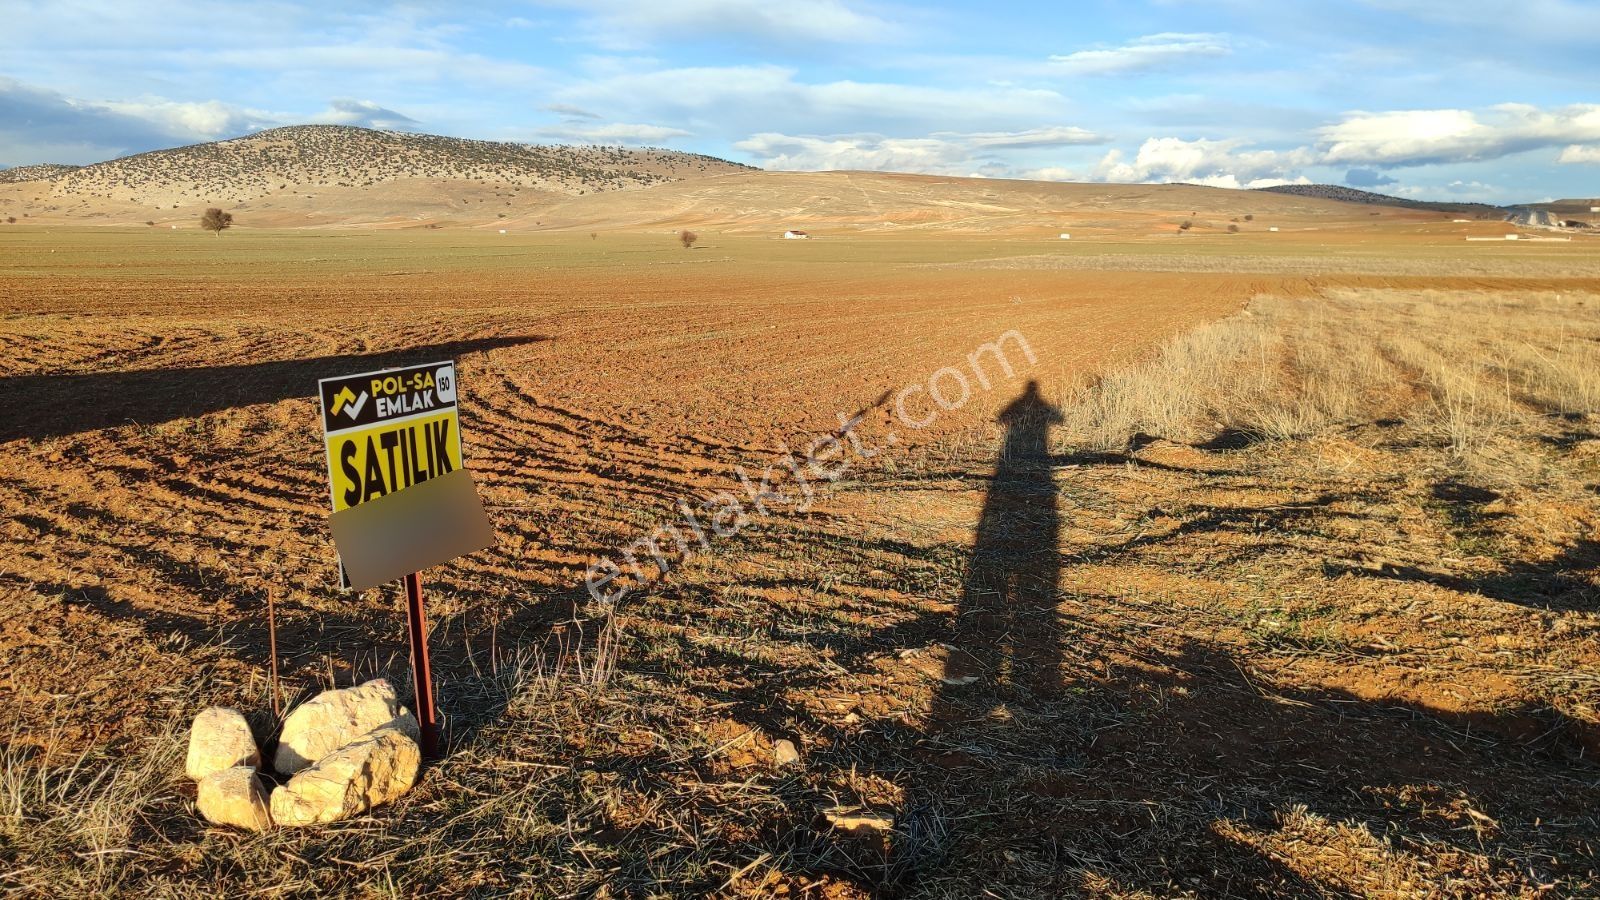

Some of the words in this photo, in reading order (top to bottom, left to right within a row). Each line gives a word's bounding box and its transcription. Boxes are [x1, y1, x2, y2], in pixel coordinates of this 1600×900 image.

[371, 371, 435, 398] POL-SA
[438, 376, 450, 391] 150
[376, 389, 435, 418] EMLAK
[340, 418, 453, 508] SATILIK
